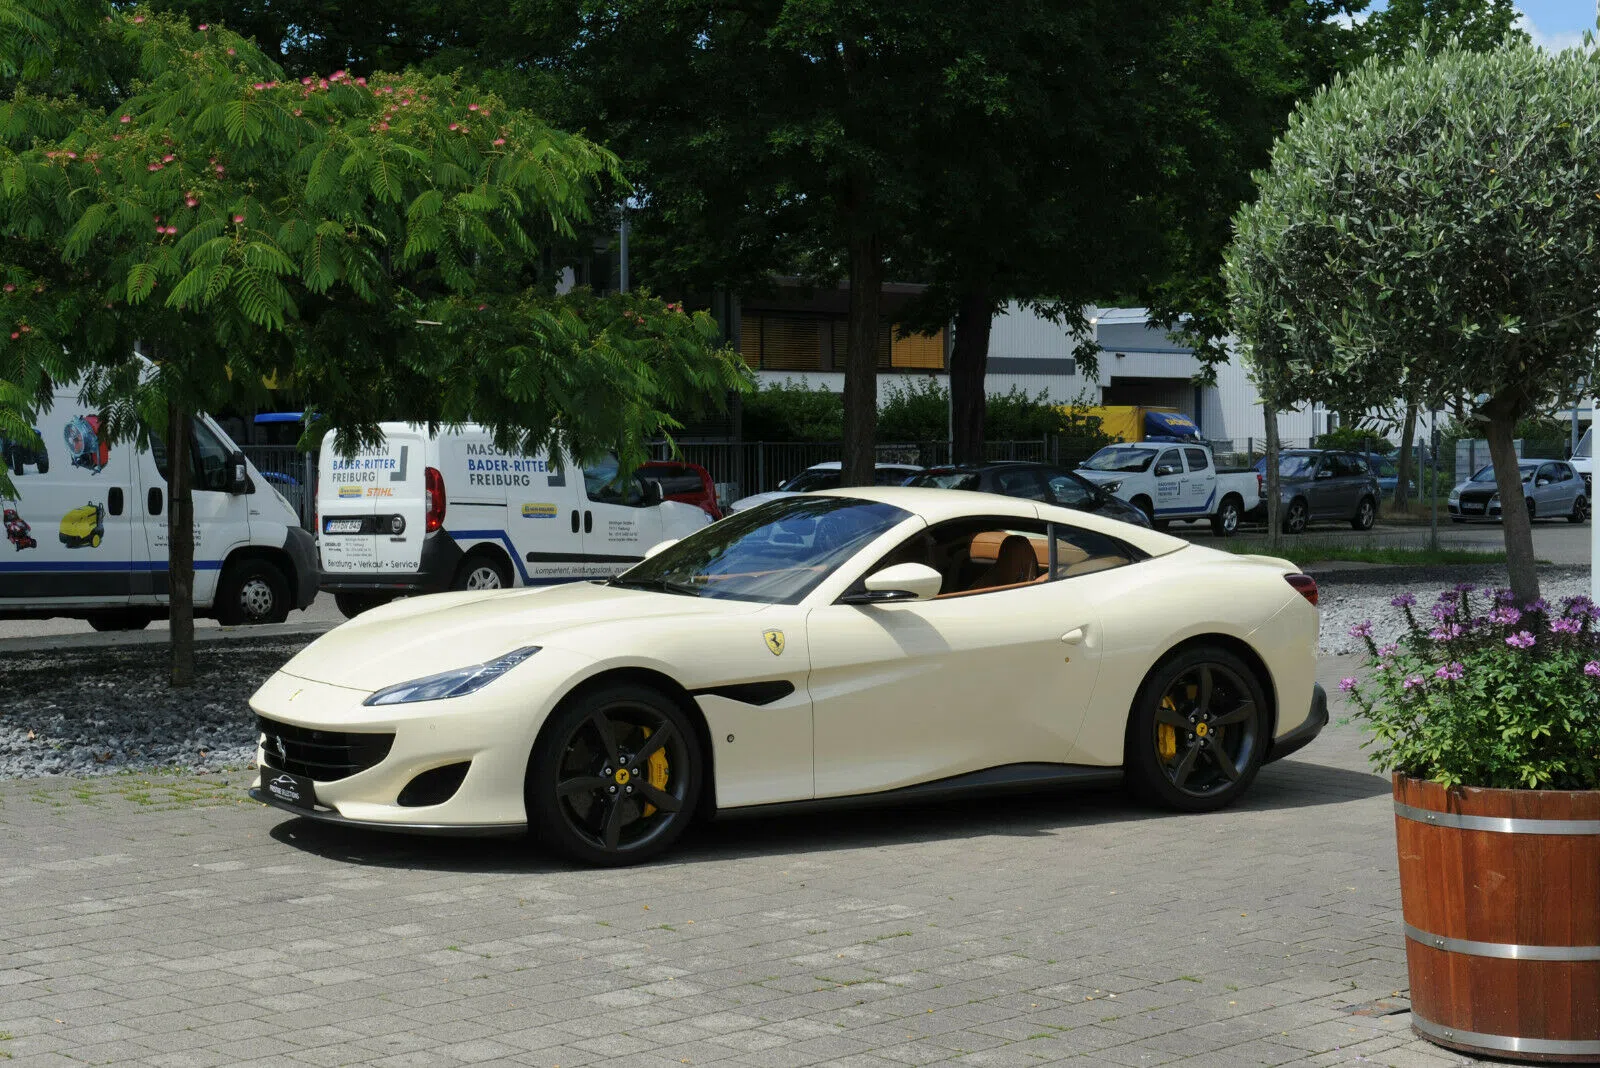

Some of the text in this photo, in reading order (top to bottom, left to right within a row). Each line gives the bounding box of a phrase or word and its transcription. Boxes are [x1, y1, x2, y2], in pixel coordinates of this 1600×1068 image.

[332, 472, 375, 483] FREIBURG
[469, 473, 530, 486] FREIBURG
[366, 487, 393, 497] STIHL
[328, 560, 419, 569] Beratung Verkauf Service
[535, 566, 571, 575] kompetent,
